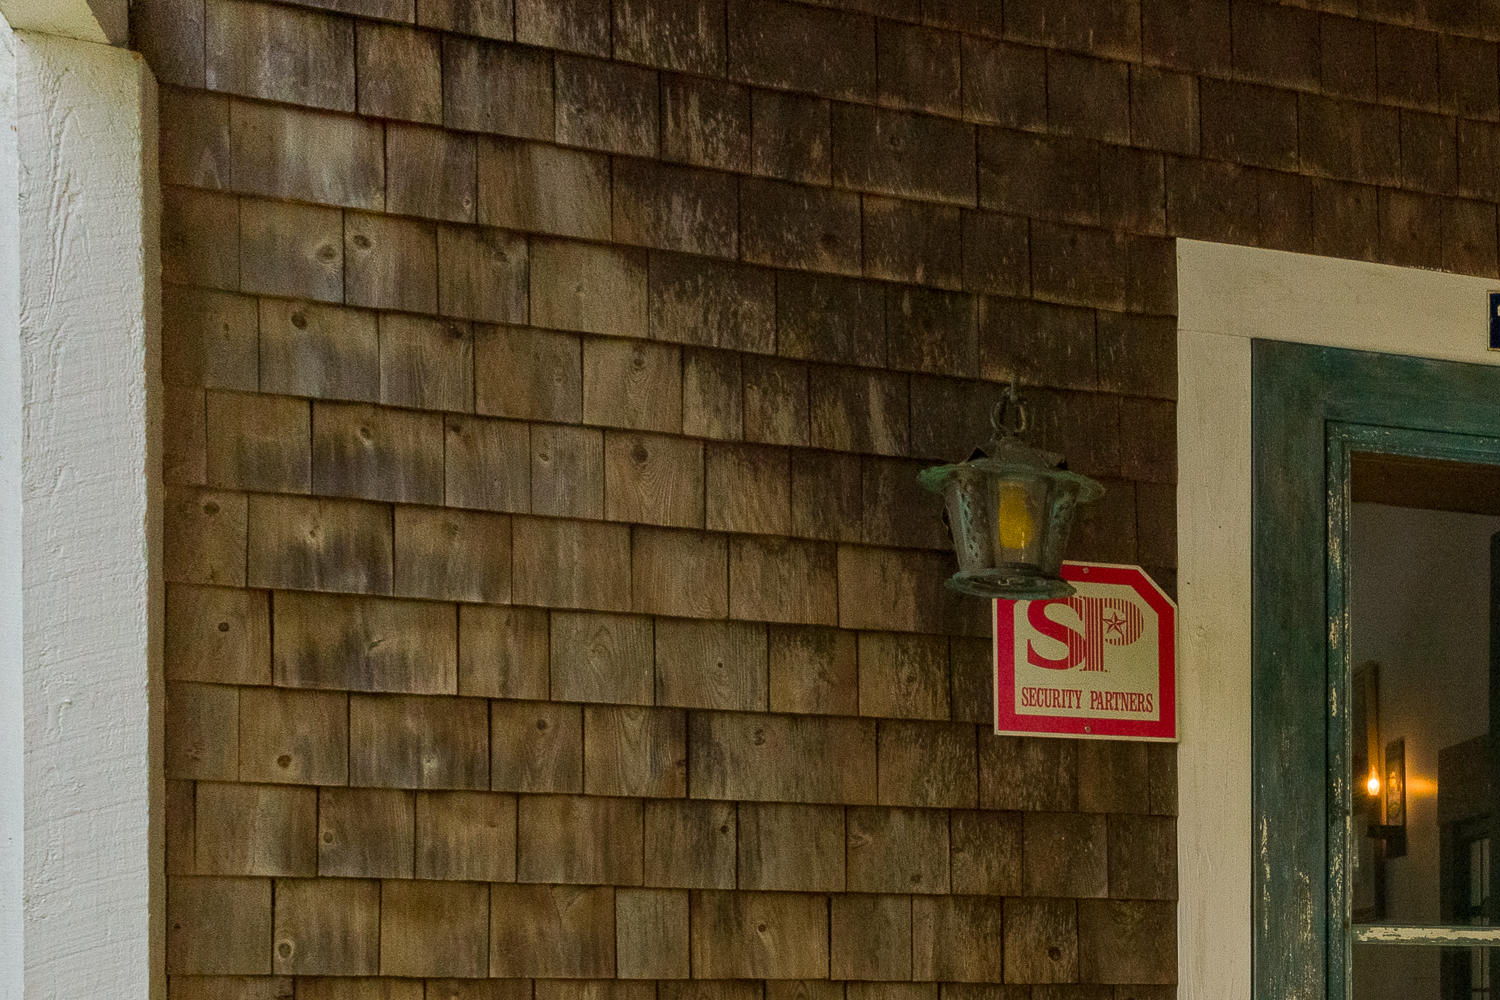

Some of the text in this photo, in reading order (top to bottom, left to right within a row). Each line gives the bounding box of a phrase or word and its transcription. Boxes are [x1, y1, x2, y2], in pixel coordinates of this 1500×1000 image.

[1027, 595, 1145, 673] SP
[1021, 686, 1154, 713] SECURITY PARTNERS
